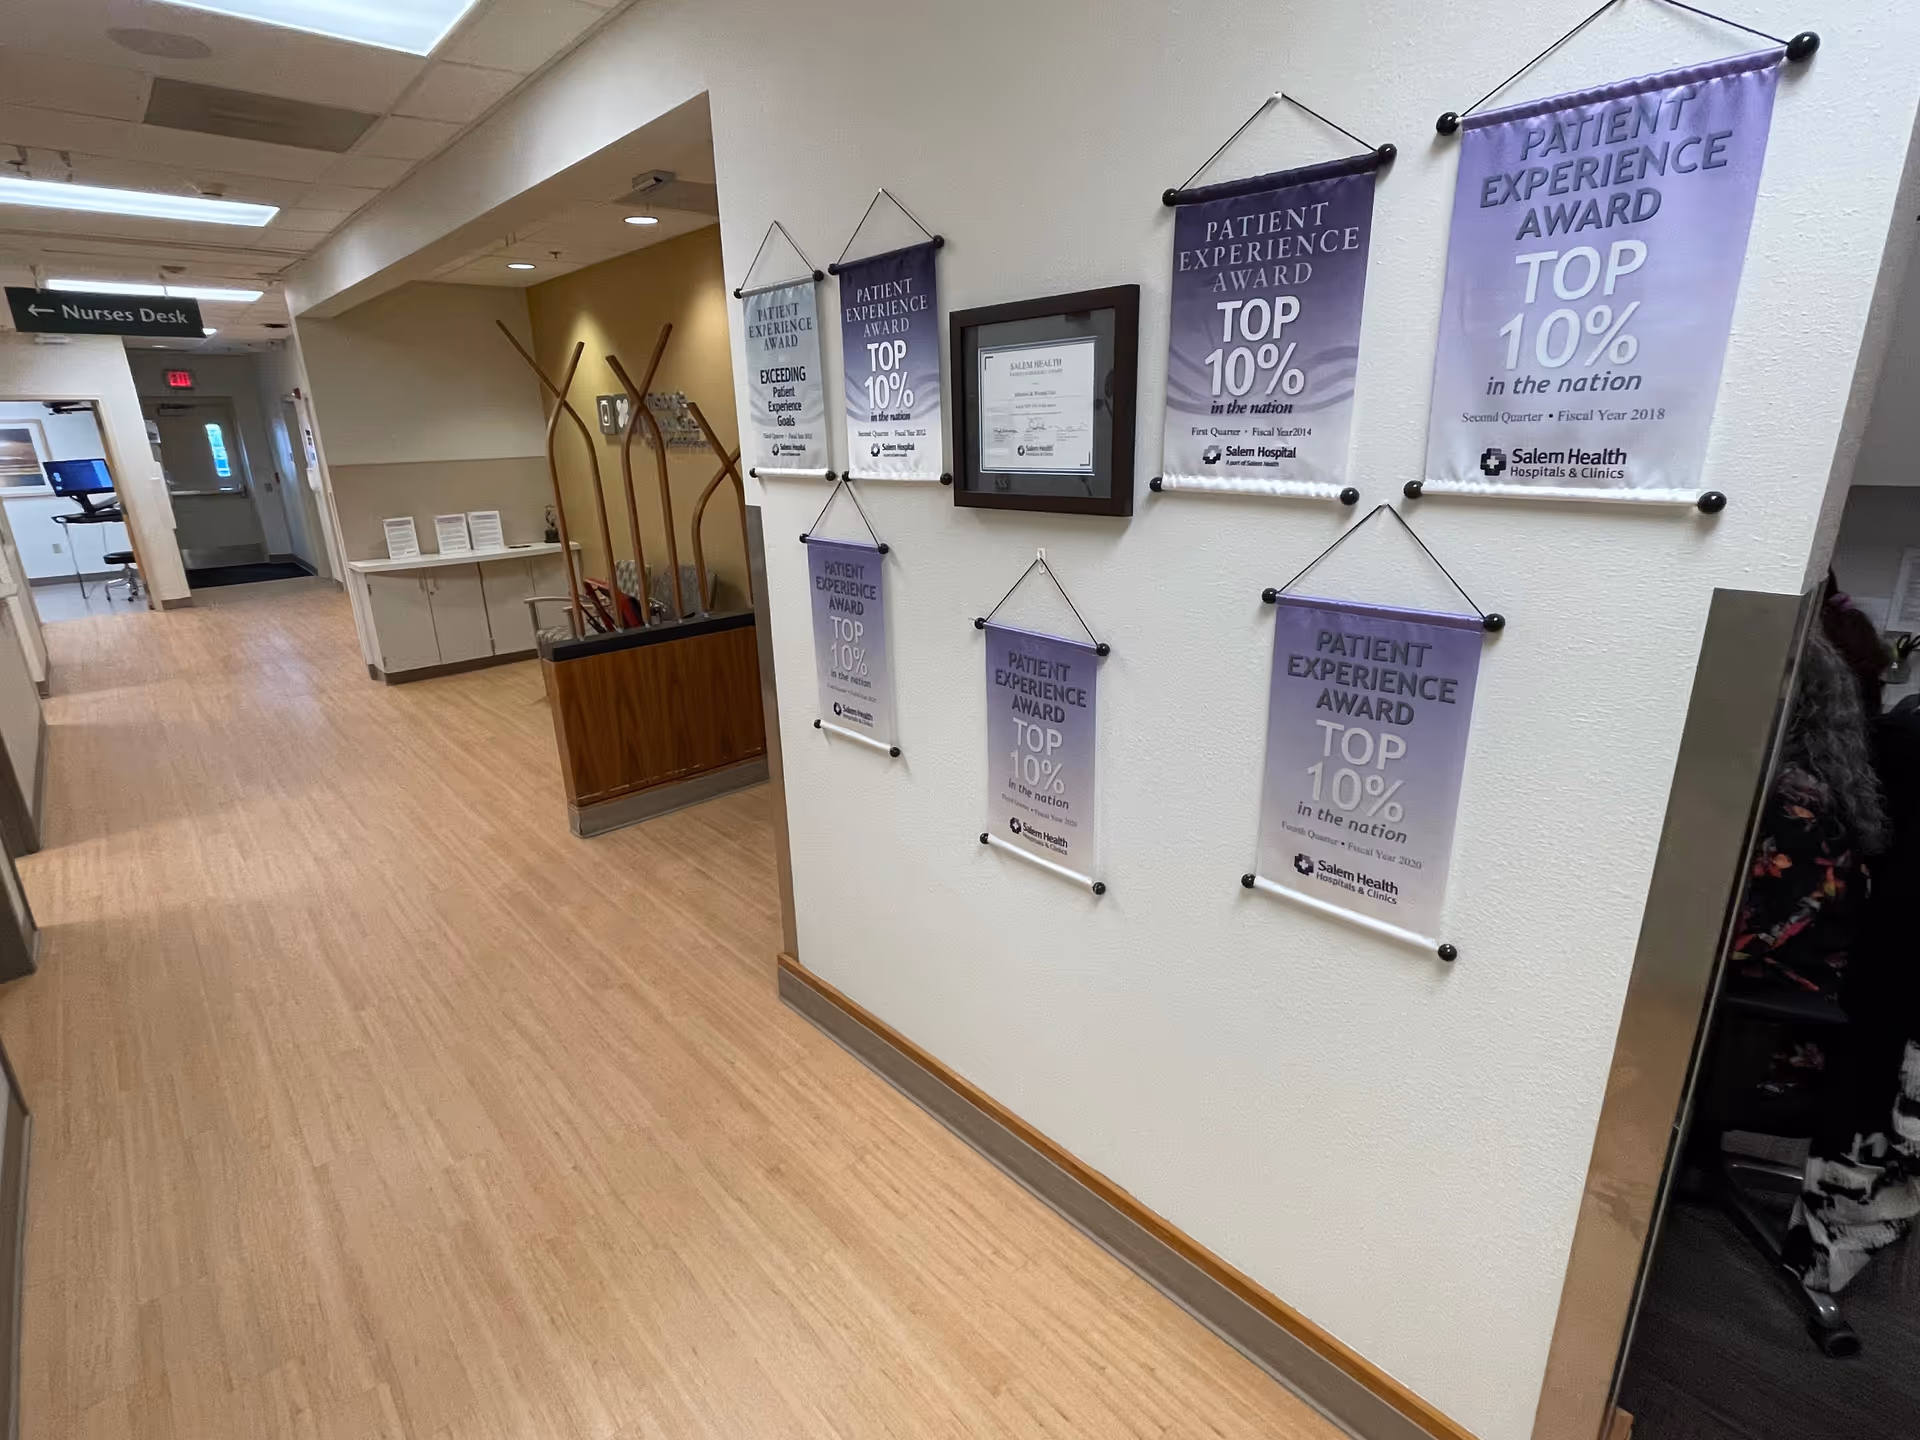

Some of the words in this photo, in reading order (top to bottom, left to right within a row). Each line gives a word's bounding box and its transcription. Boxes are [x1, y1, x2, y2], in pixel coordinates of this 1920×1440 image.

[1520, 89, 1697, 161] PATIENT
[1480, 130, 1733, 208] EXPERIENCE
[1205, 202, 1329, 242] PATIENT
[1515, 188, 1662, 240] AWARD
[1178, 227, 1360, 272] EXPERIENCE
[1212, 262, 1313, 293] AWARD
[1515, 239, 1648, 304] TOP
[857, 278, 913, 303] PATIENT
[61, 304, 135, 322] Nurses
[139, 308, 188, 324] Desk
[757, 303, 800, 321] PATIENT
[846, 294, 928, 323] EXPERIENCE
[1217, 295, 1301, 342] TOP
[749, 317, 812, 338] EXPERIENCE
[863, 317, 910, 338] AWARD
[1499, 301, 1640, 370] 10%
[764, 334, 798, 351] AWARD
[866, 339, 907, 372] TOP
[760, 366, 806, 384] EXCEEDING
[1010, 361, 1033, 370] SALEM
[1034, 358, 1062, 369] HEALTH
[1204, 342, 1305, 397] 10%
[773, 386, 795, 398] Patient
[864, 371, 914, 409] 10%
[1486, 376, 1505, 395] in
[1513, 375, 1550, 395] the
[1557, 371, 1642, 393] nation
[768, 399, 802, 414] Experience
[777, 415, 795, 426] Goals
[870, 411, 878, 422] in
[878, 411, 889, 422] the
[890, 410, 911, 421] nation
[1210, 401, 1225, 415] in
[1226, 400, 1247, 414] the
[1250, 400, 1294, 414] nation
[1461, 411, 1499, 423] Second
[1501, 411, 1543, 424] Quarter
[1557, 409, 1594, 422] Fiscal
[1597, 410, 1627, 422] Year
[1630, 408, 1665, 421] 2018
[1191, 427, 1208, 436] First
[1210, 428, 1241, 437] Quarter
[1252, 427, 1274, 436] Fiscal
[1226, 445, 1255, 457] Salem
[1258, 446, 1296, 460] Hospital
[1512, 448, 1565, 465] Salem
[1568, 448, 1627, 466] Health
[1510, 466, 1565, 479] Hospitals
[1568, 467, 1577, 478] &
[1581, 467, 1624, 479] Clinics
[824, 561, 865, 579] PATIENT
[816, 576, 876, 600] EXPERIENCE
[829, 596, 864, 616] AWARD
[830, 615, 864, 643] TOP
[831, 642, 868, 676] 10%
[1316, 631, 1432, 668] PATIENT
[838, 672, 849, 681] the
[850, 676, 871, 688] nation
[1008, 651, 1071, 681] PATIENT
[1287, 653, 1458, 704] EXPERIENCE
[995, 669, 1087, 708] EXPERIENCE
[1012, 694, 1065, 723] AWARD
[1316, 688, 1415, 725] AWARD
[1013, 717, 1062, 756] TOP
[1316, 719, 1407, 770] TOP
[1010, 749, 1065, 795] 10%
[1008, 778, 1016, 791] in
[1018, 784, 1032, 798] the
[1035, 791, 1069, 810] nation
[1306, 761, 1405, 823] 10%
[1023, 822, 1042, 839] Salem
[1044, 832, 1068, 849] Health
[1297, 801, 1312, 817] in
[1317, 808, 1344, 827] the
[1348, 820, 1407, 844] nation
[1375, 849, 1397, 863] Year
[1399, 855, 1422, 870] 2020
[1316, 872, 1355, 892] Hospitals
[1358, 886, 1365, 895] &
[1367, 888, 1397, 905] Clinics
[1318, 860, 1354, 881] Salem
[1357, 872, 1398, 895] Health
